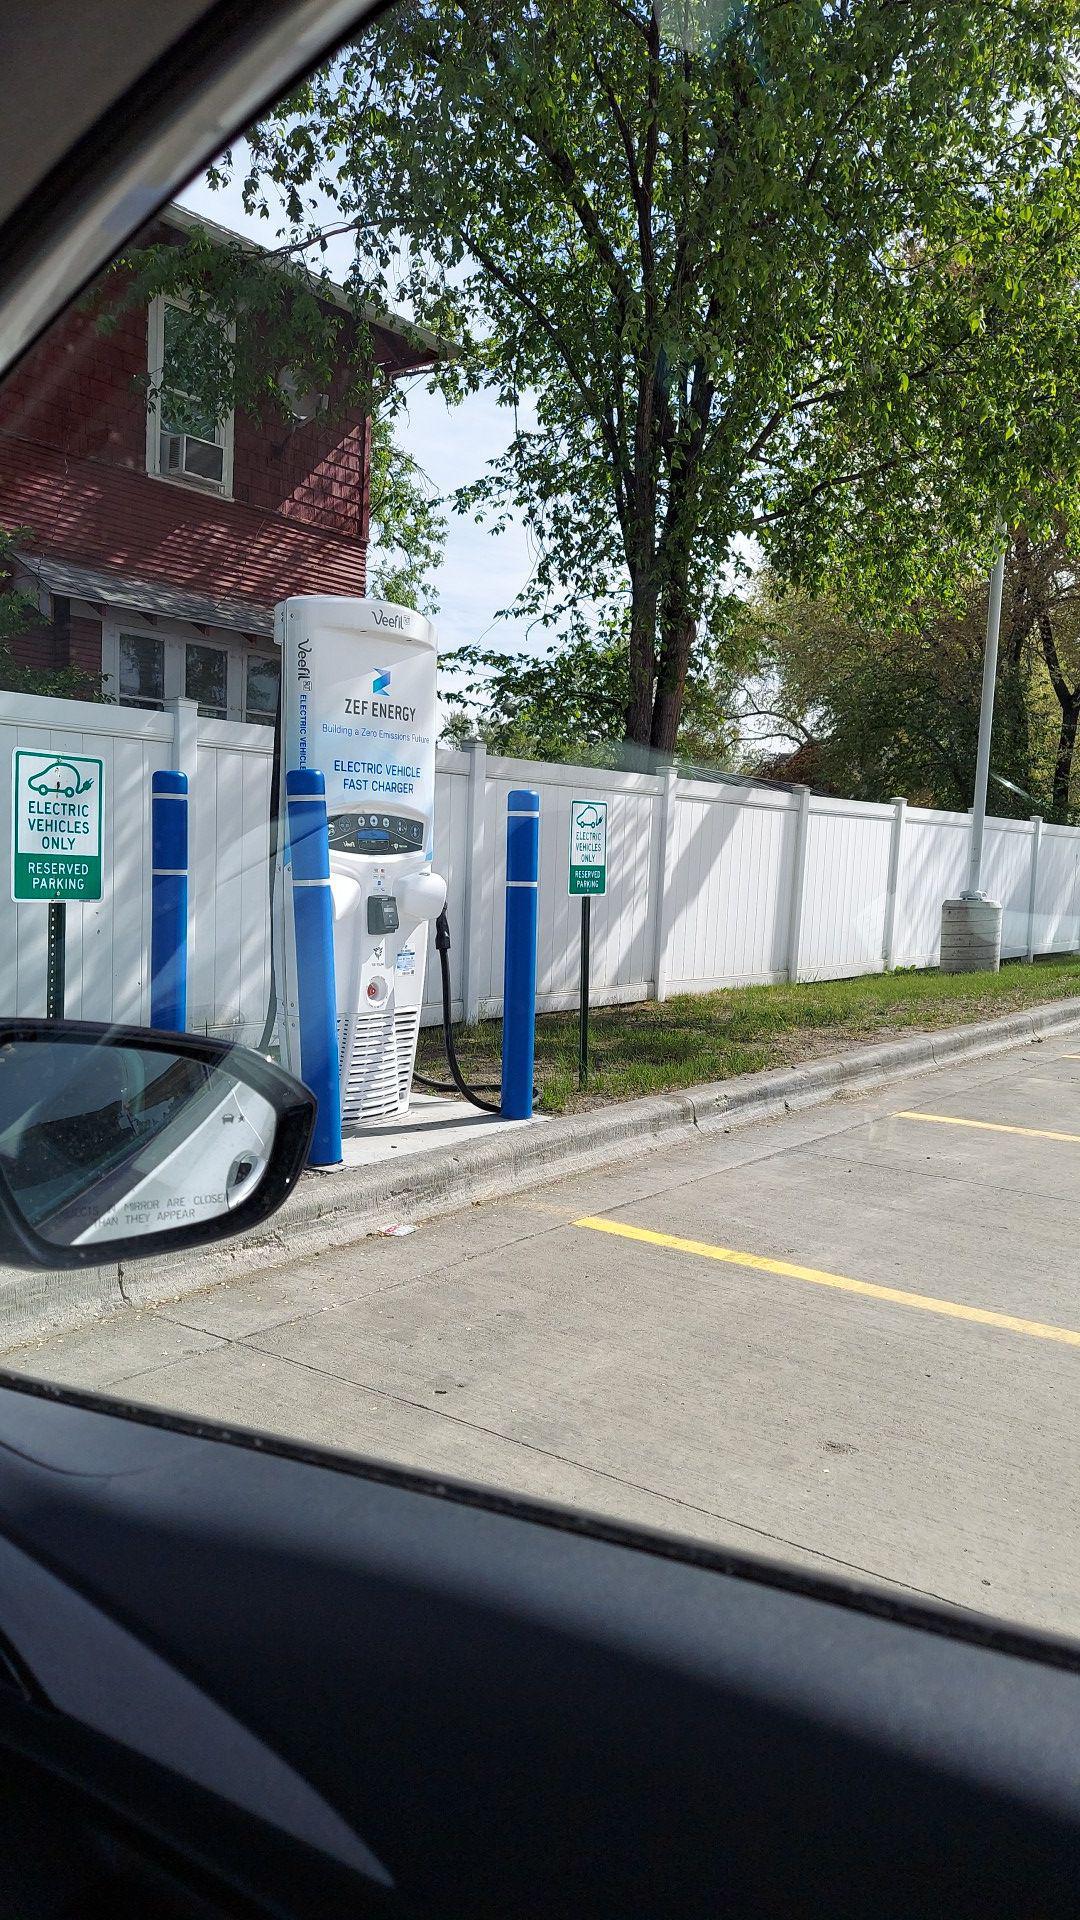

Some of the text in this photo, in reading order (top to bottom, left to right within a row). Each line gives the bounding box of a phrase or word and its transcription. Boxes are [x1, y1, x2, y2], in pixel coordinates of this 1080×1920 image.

[371, 609, 405, 630] Veefil
[297, 638, 312, 681] Veefil
[345, 698, 416, 722] ZEF ENERGY
[322, 723, 353, 737] Building
[361, 727, 377, 738] Zero
[379, 730, 411, 742] Emissions
[411, 733, 430, 744] Future
[299, 737, 307, 770] VEHICLE
[334, 760, 421, 778] ELECTRIC VEHICLE
[343, 779, 414, 794] FAST CHARGER
[28, 800, 89, 817] ELECTRIC
[28, 818, 90, 835] VEHICLES
[42, 836, 76, 850] ONLY
[576, 831, 601, 841] ELECTRIC
[576, 842, 601, 852] VEHICLES
[581, 854, 596, 863] ONLY
[28, 862, 89, 875] RESERVED
[575, 870, 601, 878] RESERVED
[32, 877, 85, 890] PARKING
[576, 880, 599, 888] PARKING
[124, 1199, 160, 1212] MIRROR
[167, 1197, 186, 1208] ARE
[125, 1213, 151, 1224] THEY
[157, 1209, 195, 1221] APPEAR
